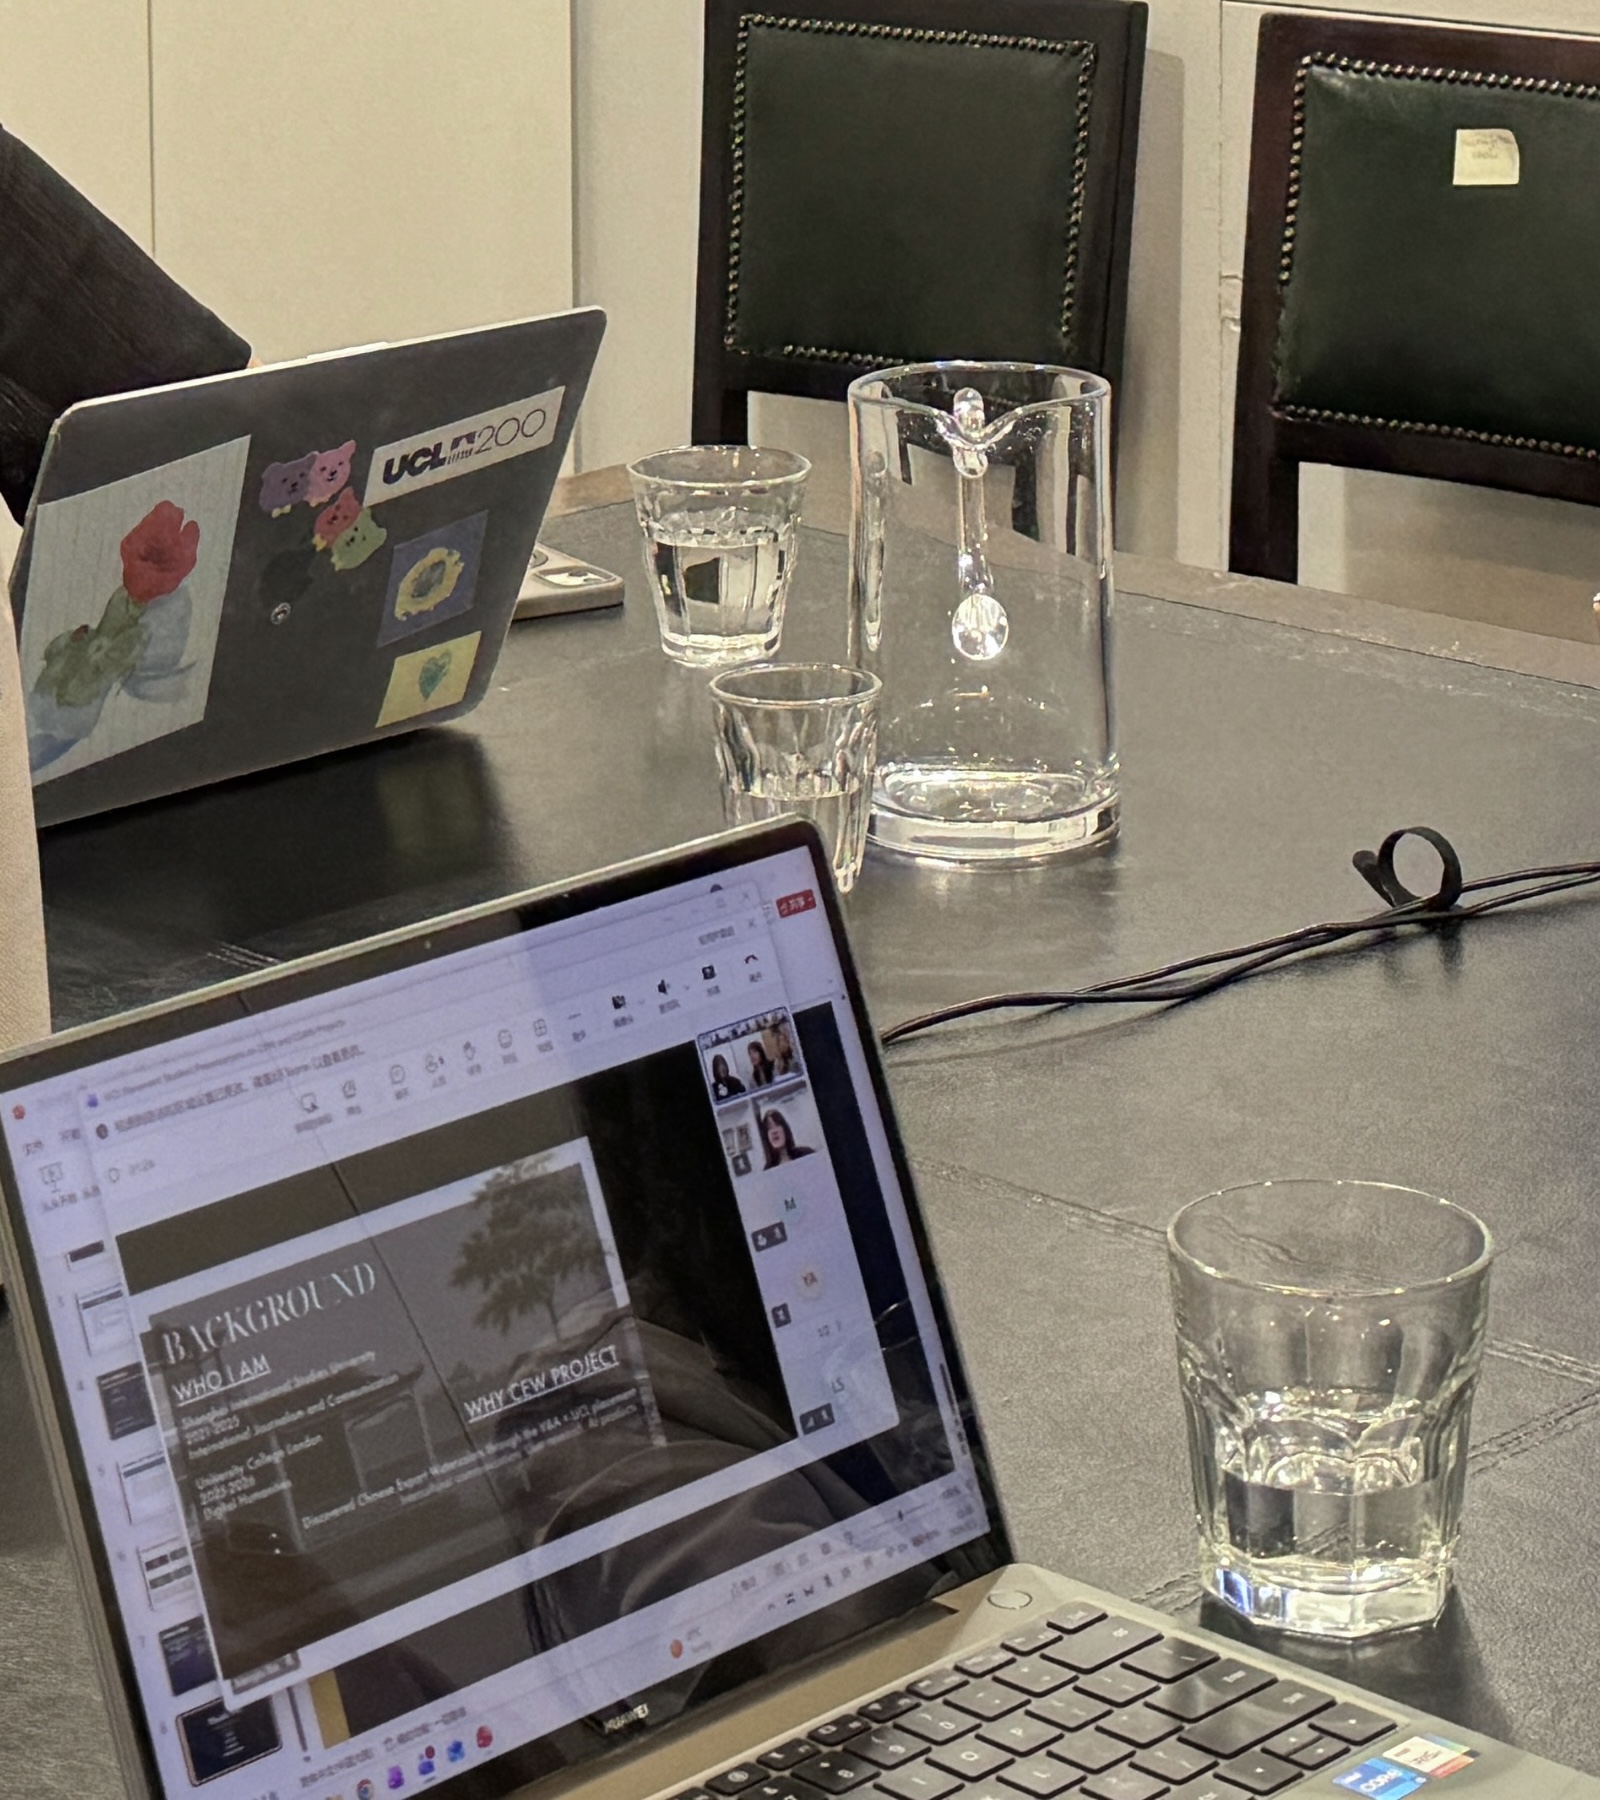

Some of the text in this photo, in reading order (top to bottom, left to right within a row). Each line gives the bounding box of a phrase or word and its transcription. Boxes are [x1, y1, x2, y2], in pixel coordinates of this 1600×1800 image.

[383, 408, 547, 485] UCL 200
[163, 1262, 376, 1365] BACKGROUND
[172, 1371, 223, 1400] WHO
[240, 1354, 270, 1379] AM
[464, 1389, 505, 1418] WHY
[551, 1345, 618, 1387] PROJECT
